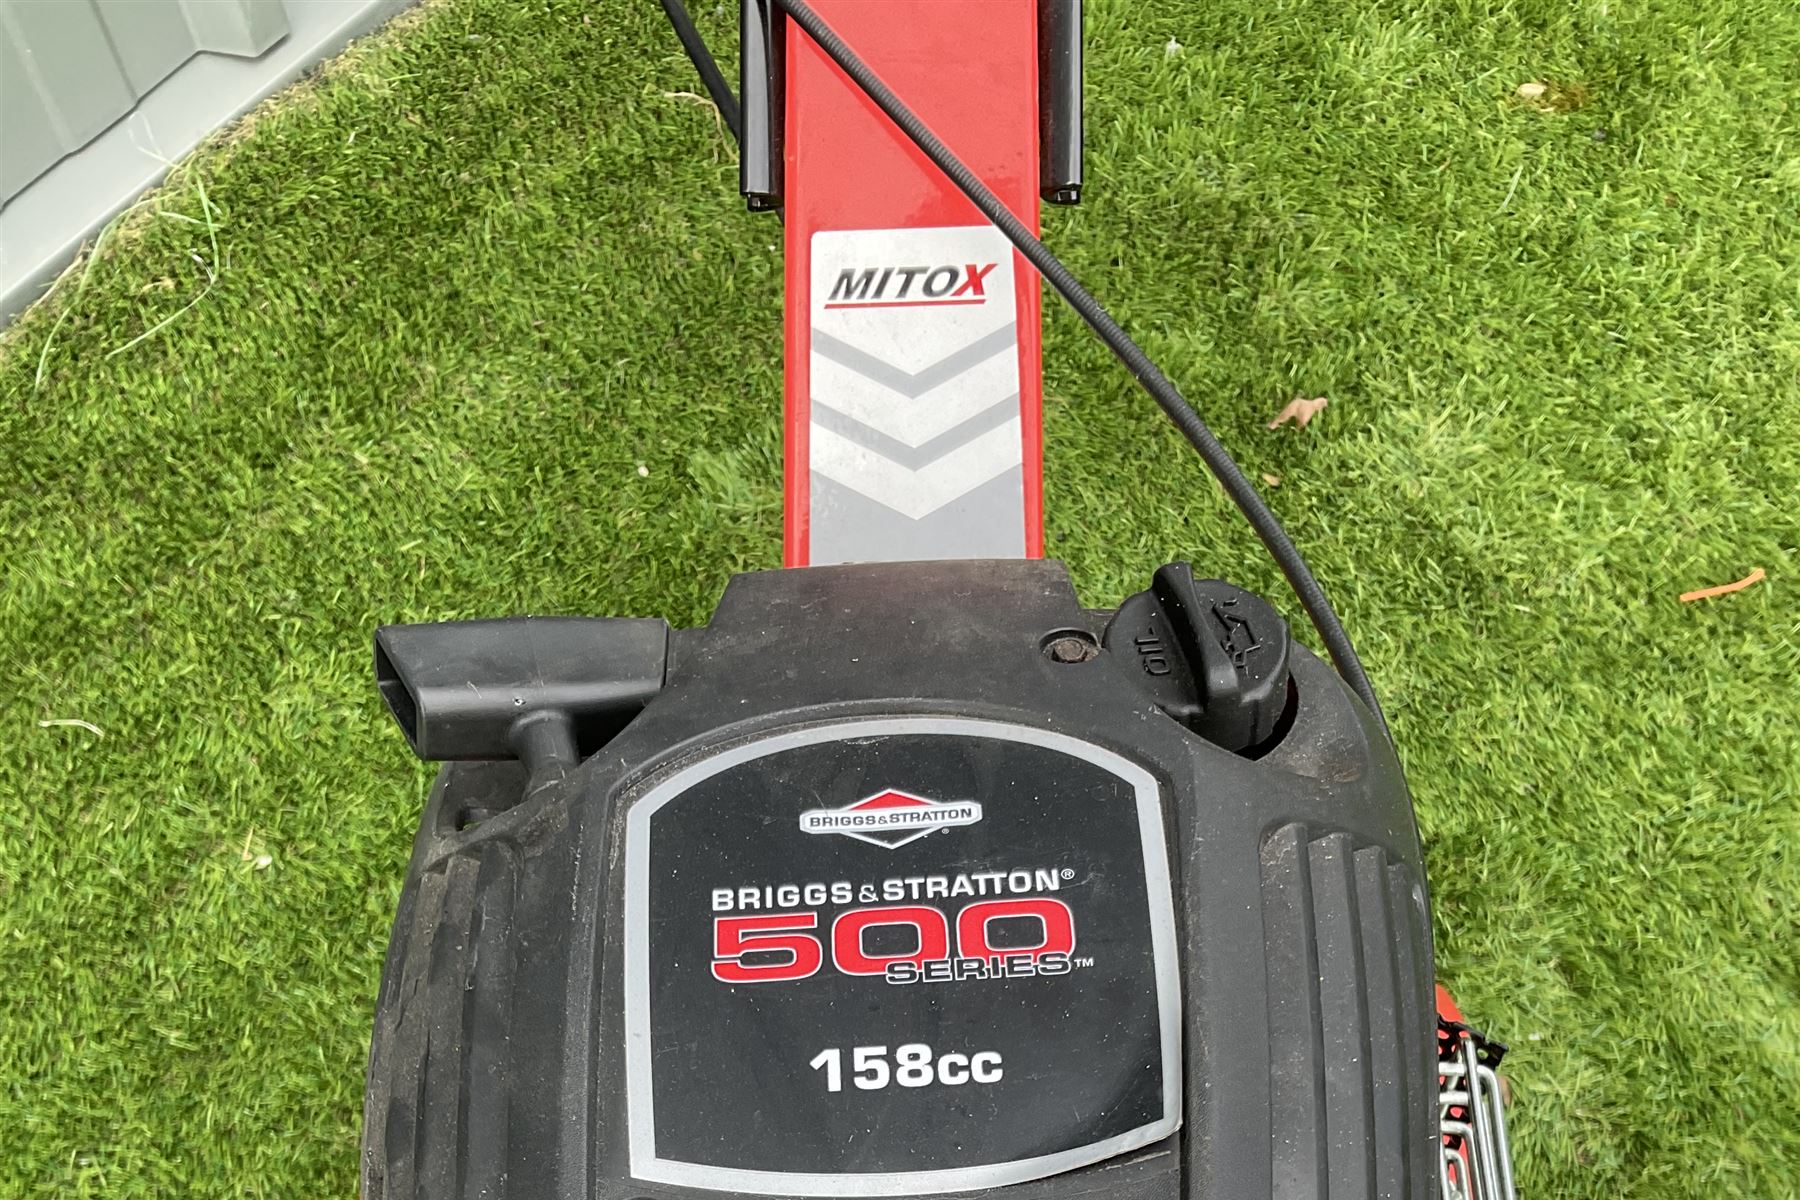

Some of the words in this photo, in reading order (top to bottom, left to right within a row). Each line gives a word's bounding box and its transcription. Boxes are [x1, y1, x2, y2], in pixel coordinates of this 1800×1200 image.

[828, 263, 998, 300] MITOX
[711, 898, 1076, 983] 500
[809, 1043, 1004, 1092] 158cc
